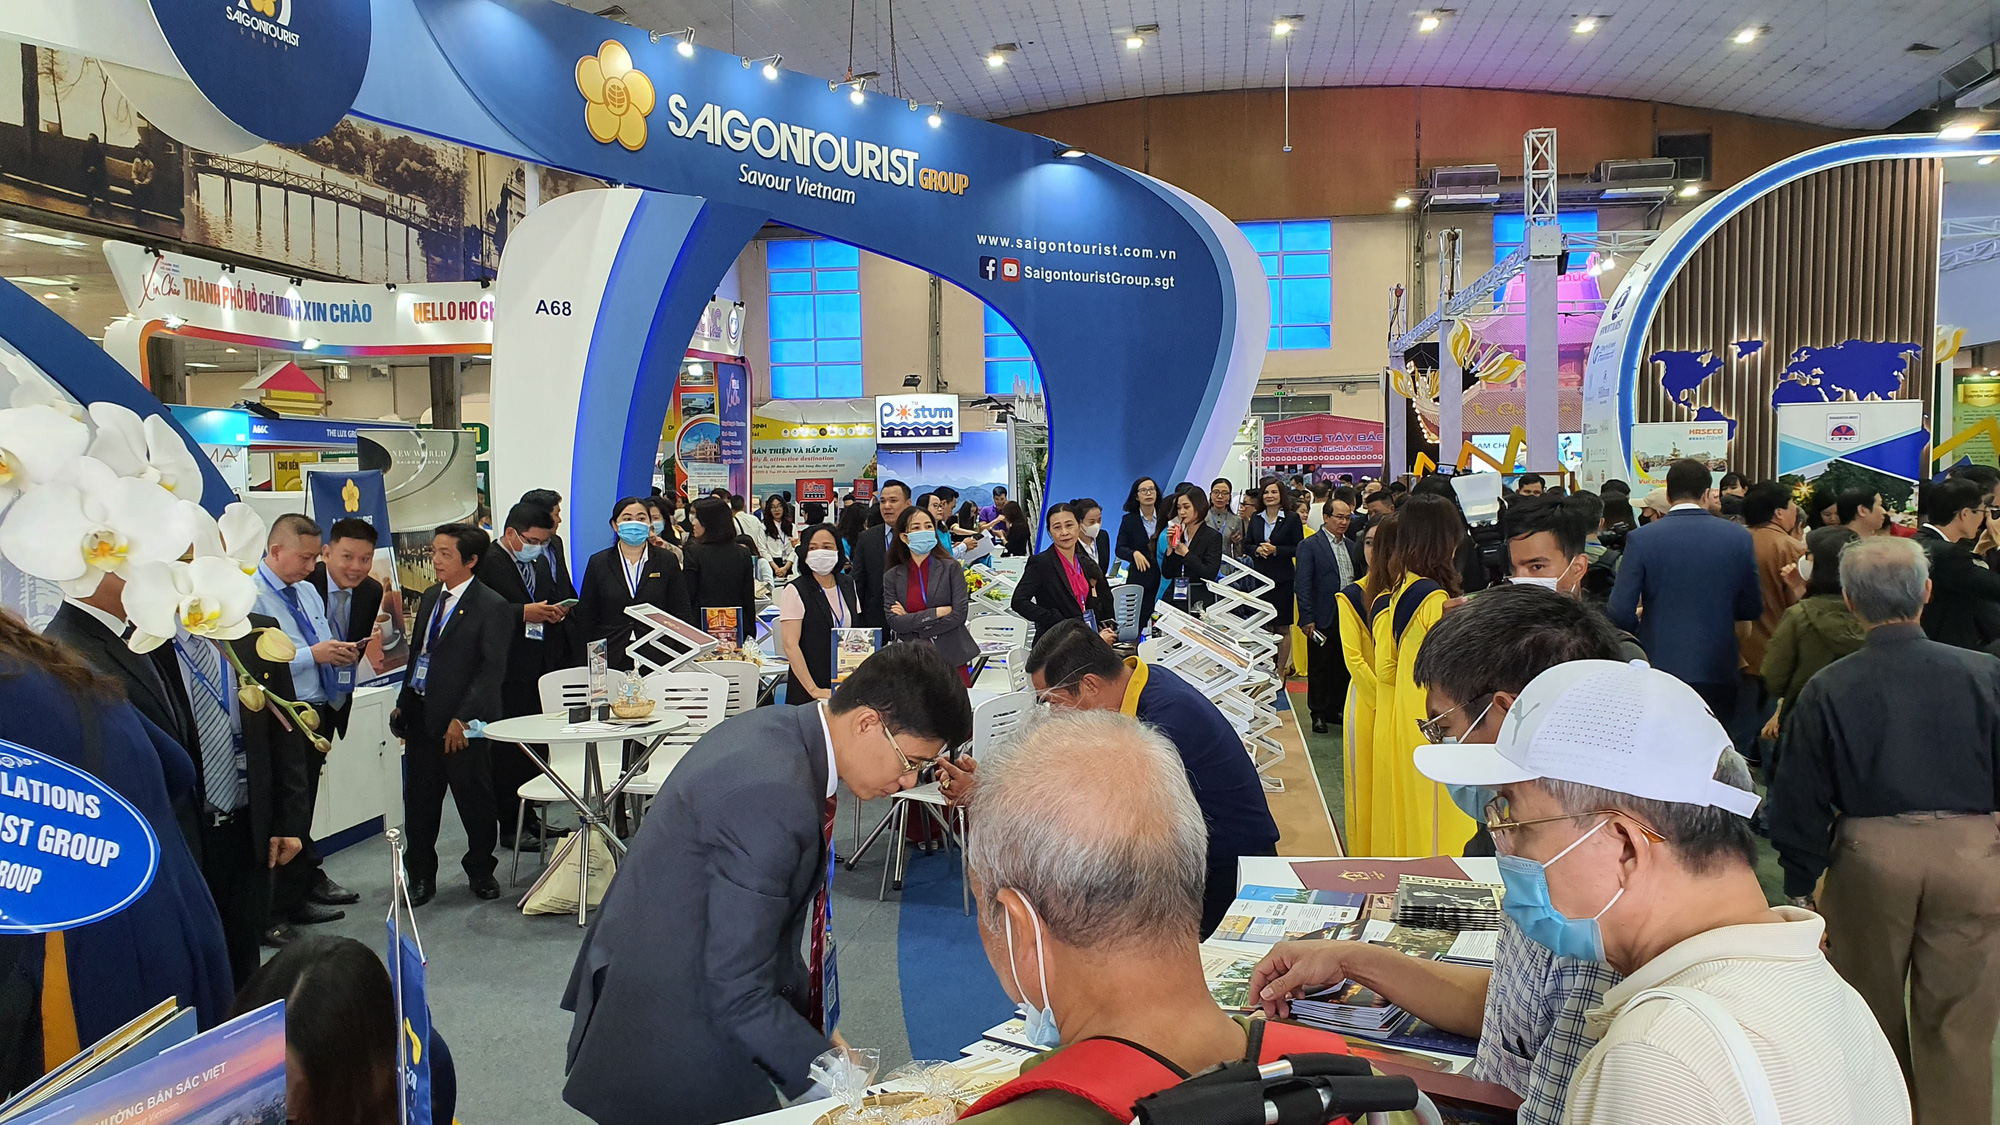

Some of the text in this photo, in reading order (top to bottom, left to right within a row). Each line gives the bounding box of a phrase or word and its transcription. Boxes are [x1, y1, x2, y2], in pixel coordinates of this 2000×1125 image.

[226, 5, 300, 47] SAIGONTOURIST
[668, 94, 970, 195] SAIGONTOURIST GROUP
[738, 163, 856, 204] Savour Vietnam
[976, 233, 1177, 260] www.saigontourist.com.vn
[1024, 265, 1175, 290] SaigontouristGroup.sgt
[183, 276, 372, 323] THÀNH PHỐ HỒ CHÍ MINH XIN CHÀO
[535, 299, 572, 316] A68
[413, 301, 456, 324] HELLO
[459, 301, 478, 321] HO
[252, 425, 269, 434] A66C
[326, 429, 337, 437] THE
[882, 428, 952, 437] TRAVEL
[1285, 433, 1322, 443] VÙNG
[1325, 432, 1354, 443] TÂY
[793, 445, 804, 454] VÀ
[1263, 444, 1373, 455] NORTHERN HIGHLANDS
[37, 824, 120, 868] GROUP
[147, 1088, 173, 1109] BẢN
[175, 1075, 200, 1096] SẮC
[202, 1062, 227, 1082] VIỆT
